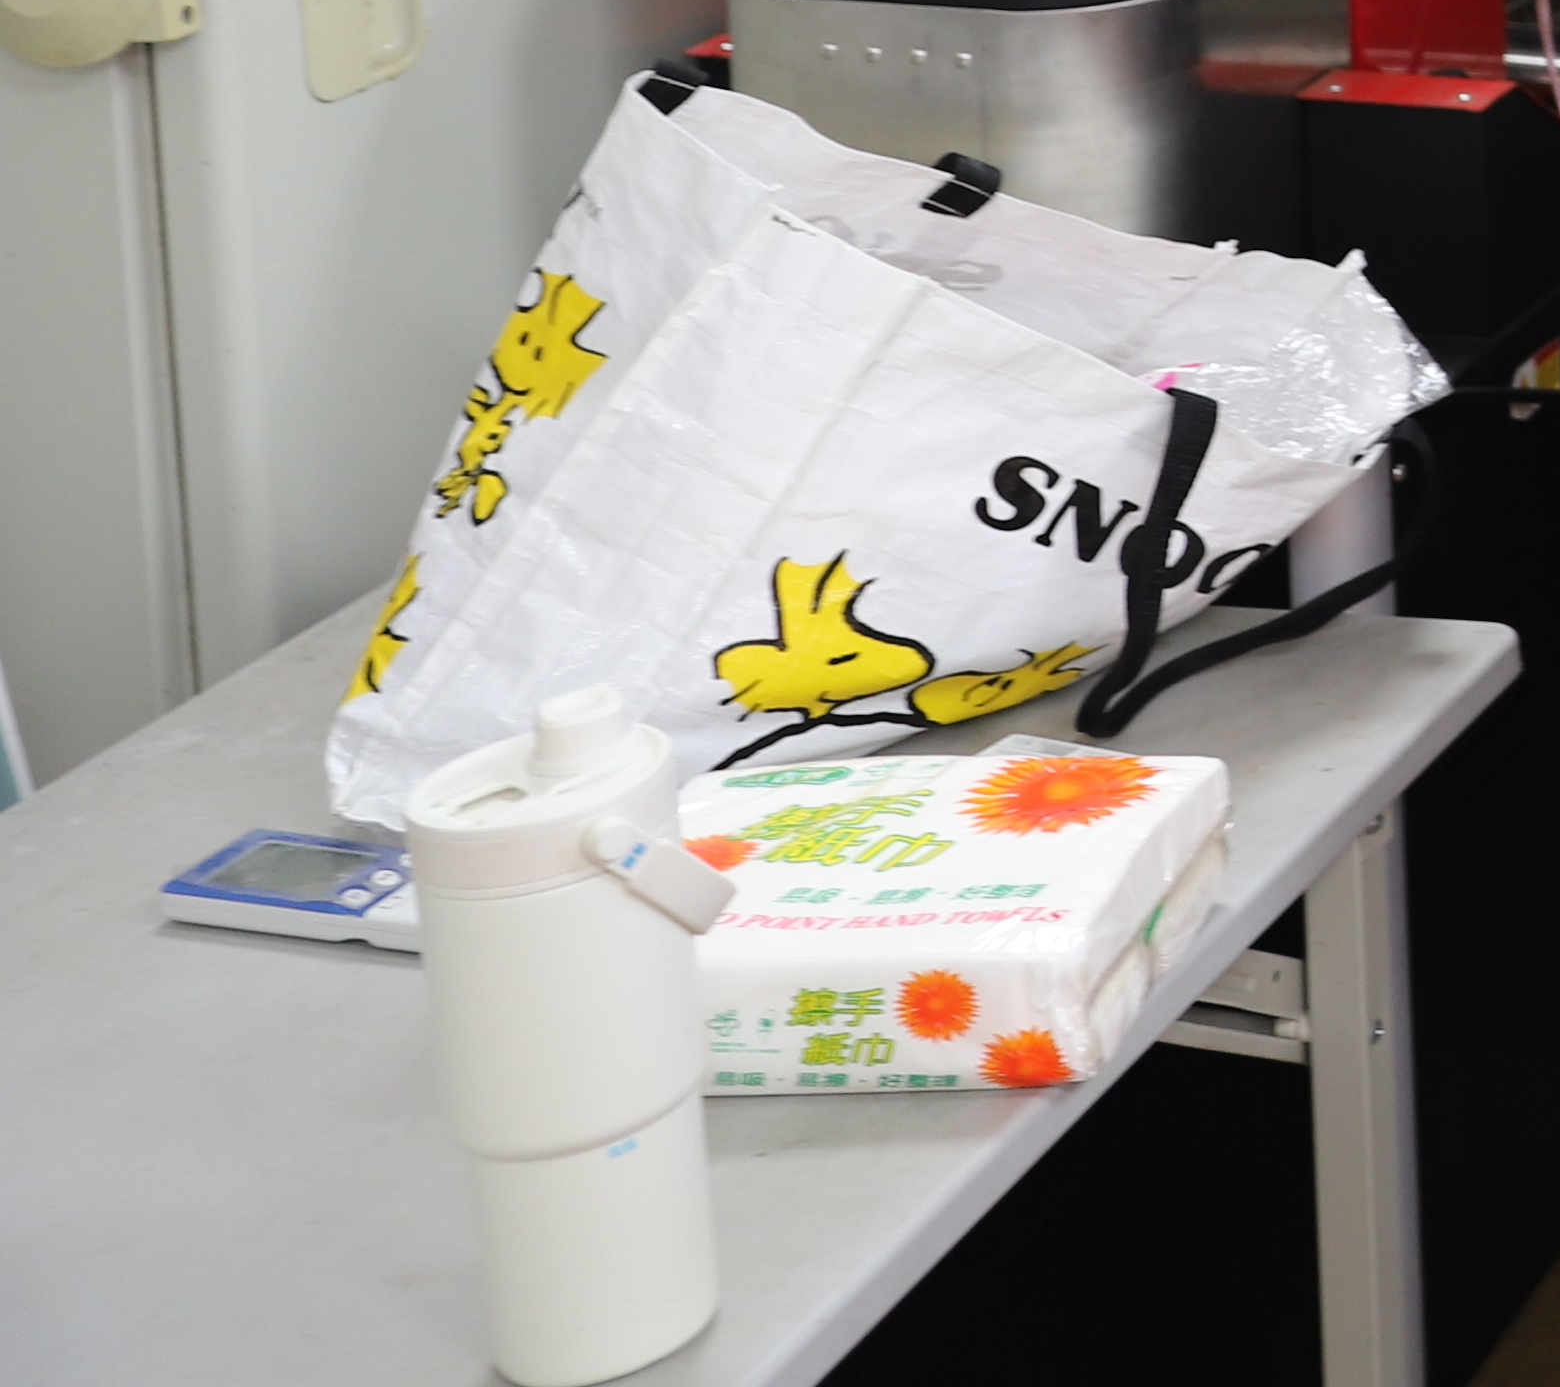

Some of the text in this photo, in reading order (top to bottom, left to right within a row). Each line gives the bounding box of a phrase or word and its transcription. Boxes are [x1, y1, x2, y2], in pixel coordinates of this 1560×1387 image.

[755, 825, 956, 872] 紙巾
[734, 913, 848, 930] POINT
[838, 911, 940, 929] HAND
[785, 987, 885, 1027] 擦手
[800, 1031, 896, 1067] 紙巾
